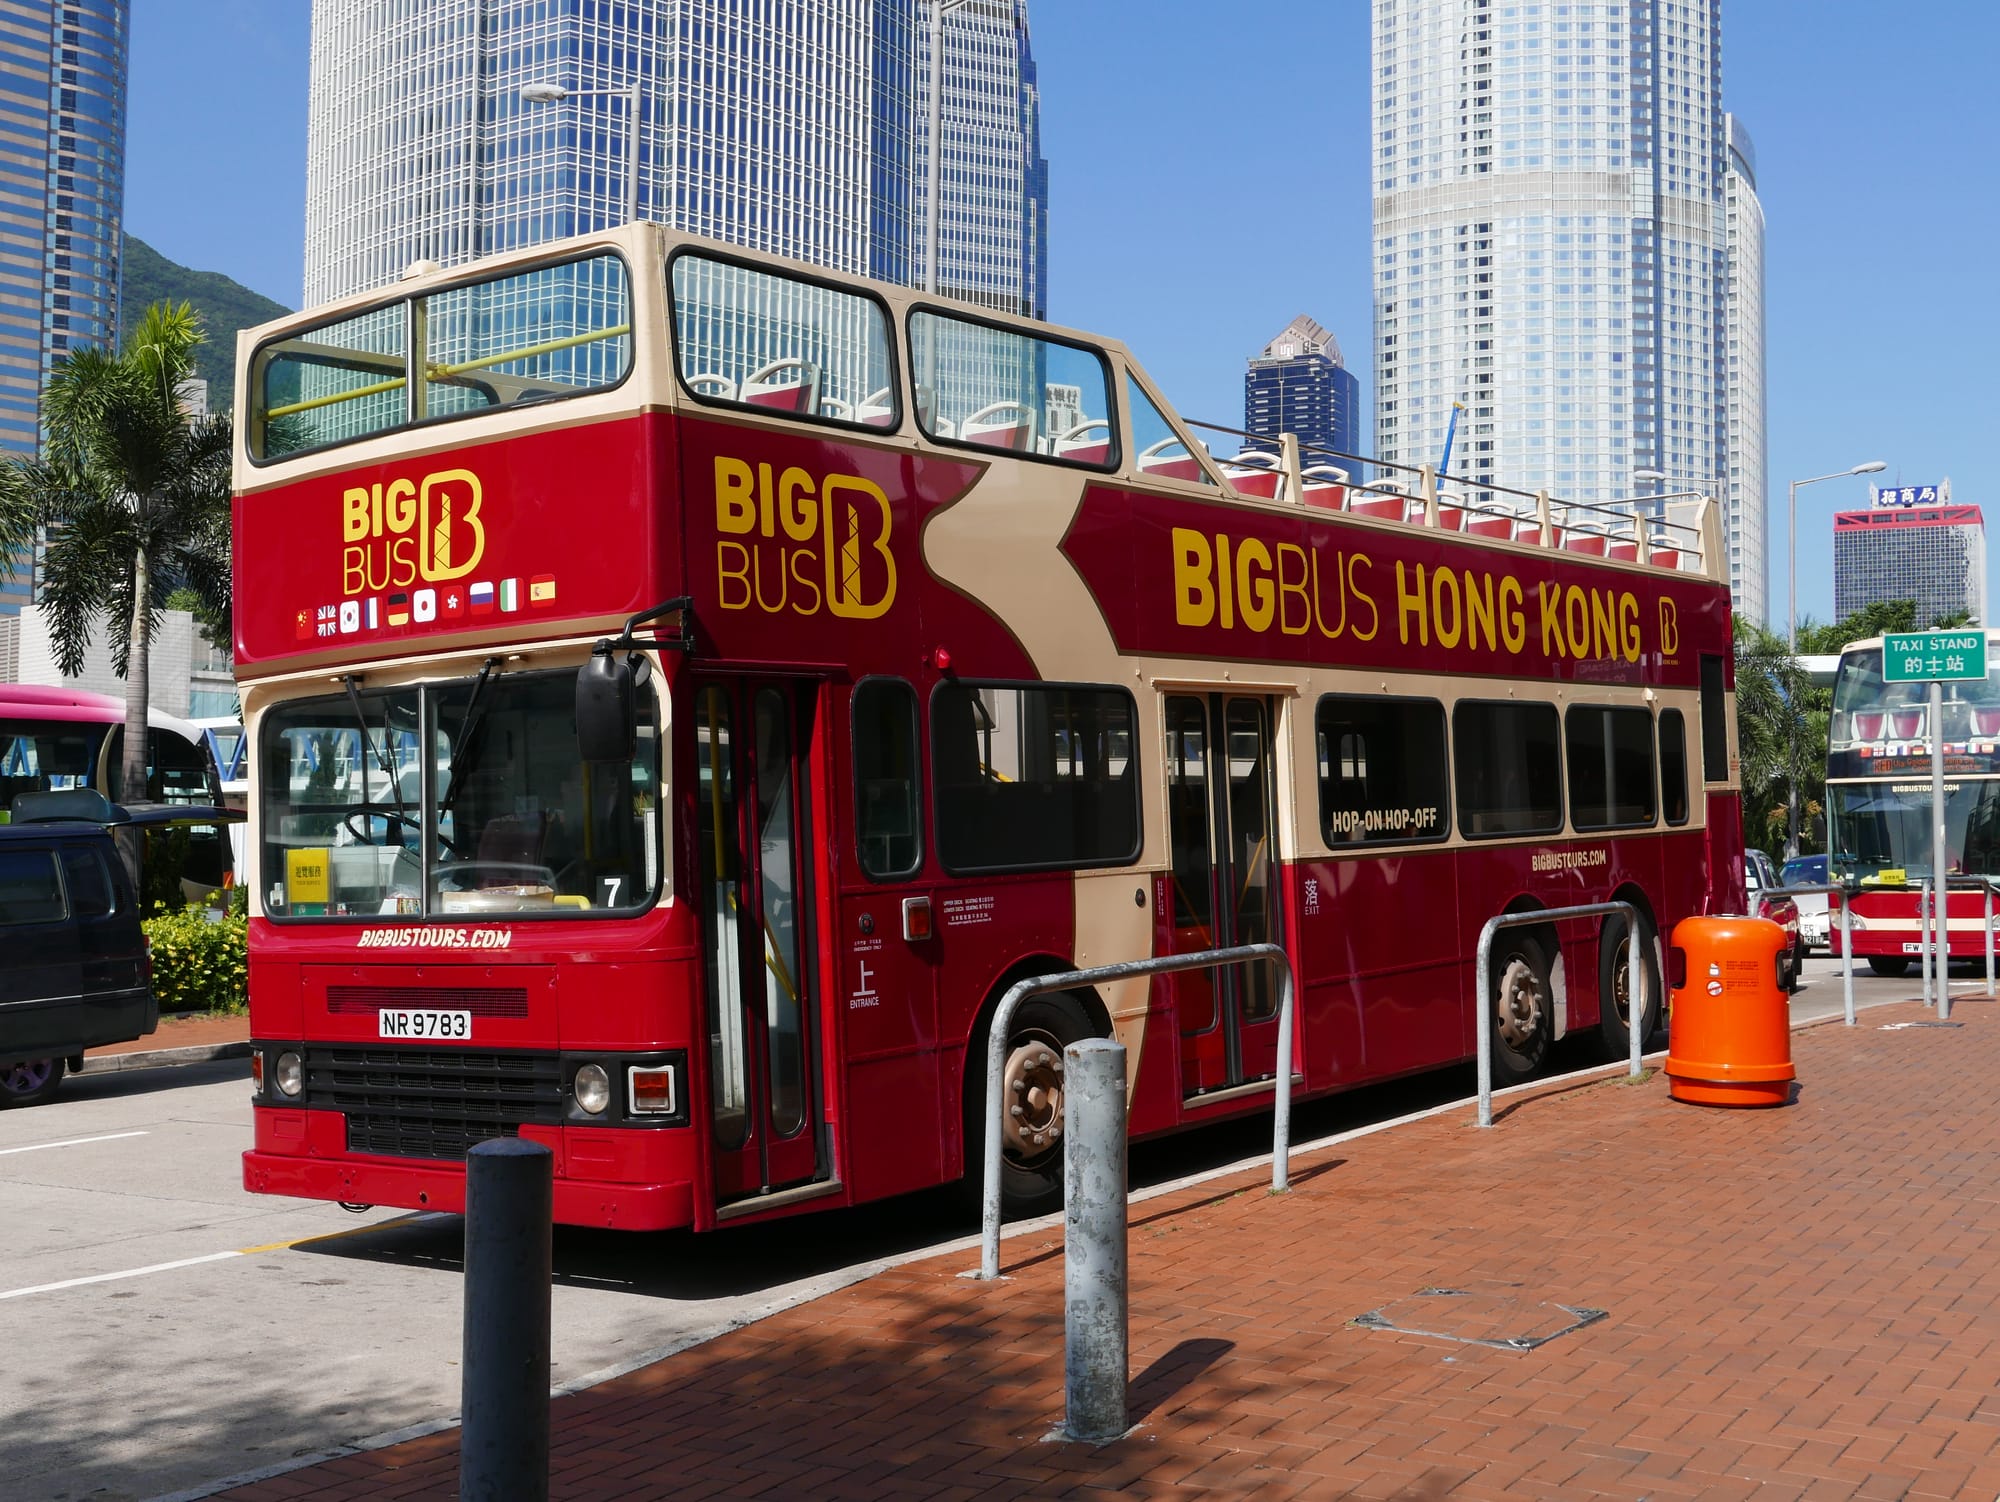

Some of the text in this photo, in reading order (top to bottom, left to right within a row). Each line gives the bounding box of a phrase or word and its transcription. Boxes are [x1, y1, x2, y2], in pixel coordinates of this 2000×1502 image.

[714, 456, 818, 542] BIG
[1881, 488, 1936, 504] 招商局
[343, 478, 417, 543] BIG
[343, 537, 416, 595] BUS
[717, 540, 821, 616] BUS
[1395, 559, 1526, 654] HONG
[1538, 580, 1641, 663] KONG
[1892, 637, 1977, 652] TAXI STAND
[1904, 655, 1964, 673] 的士站
[1332, 807, 1437, 833] HOP-ON HOP-OFF
[1532, 850, 1606, 872] BIGBUSTOURS.COM
[604, 878, 622, 908] 7
[1305, 879, 1318, 905] 落
[1305, 905, 1320, 916] EXIT
[357, 927, 512, 949] BIGBUSTOURS.COM
[853, 960, 876, 997] 上
[849, 996, 880, 1009] ENTRANCE
